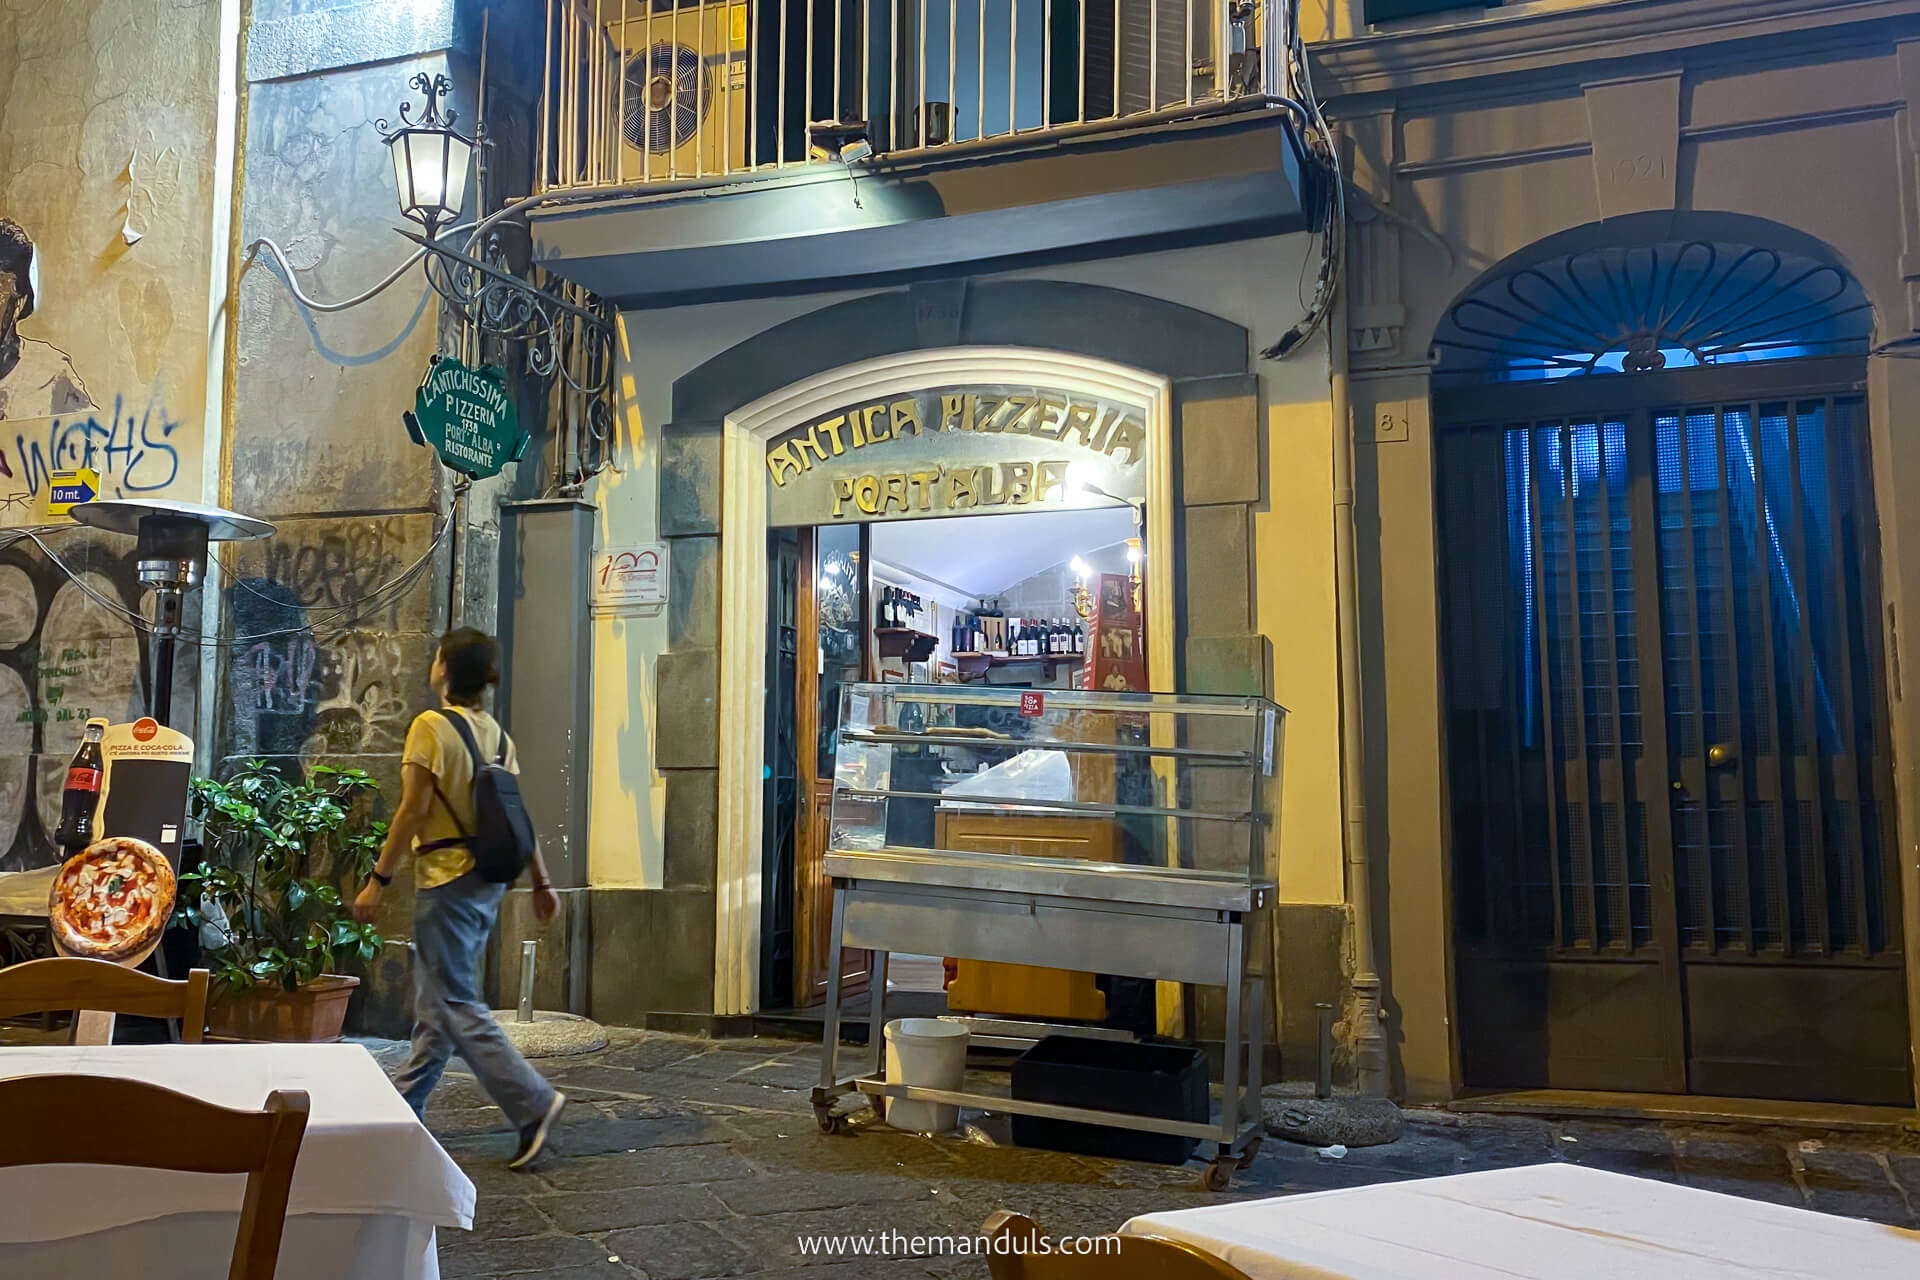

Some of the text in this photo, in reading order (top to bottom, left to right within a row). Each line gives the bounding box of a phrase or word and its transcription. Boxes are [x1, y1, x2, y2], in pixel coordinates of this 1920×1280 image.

[445, 394, 496, 429] PIZZERIA
[1381, 413, 1394, 432] 8
[445, 439, 494, 468] RISTORANTE
[766, 393, 1146, 487] ANTICA PIZZERIA
[53, 489, 81, 500] 10 mt.
